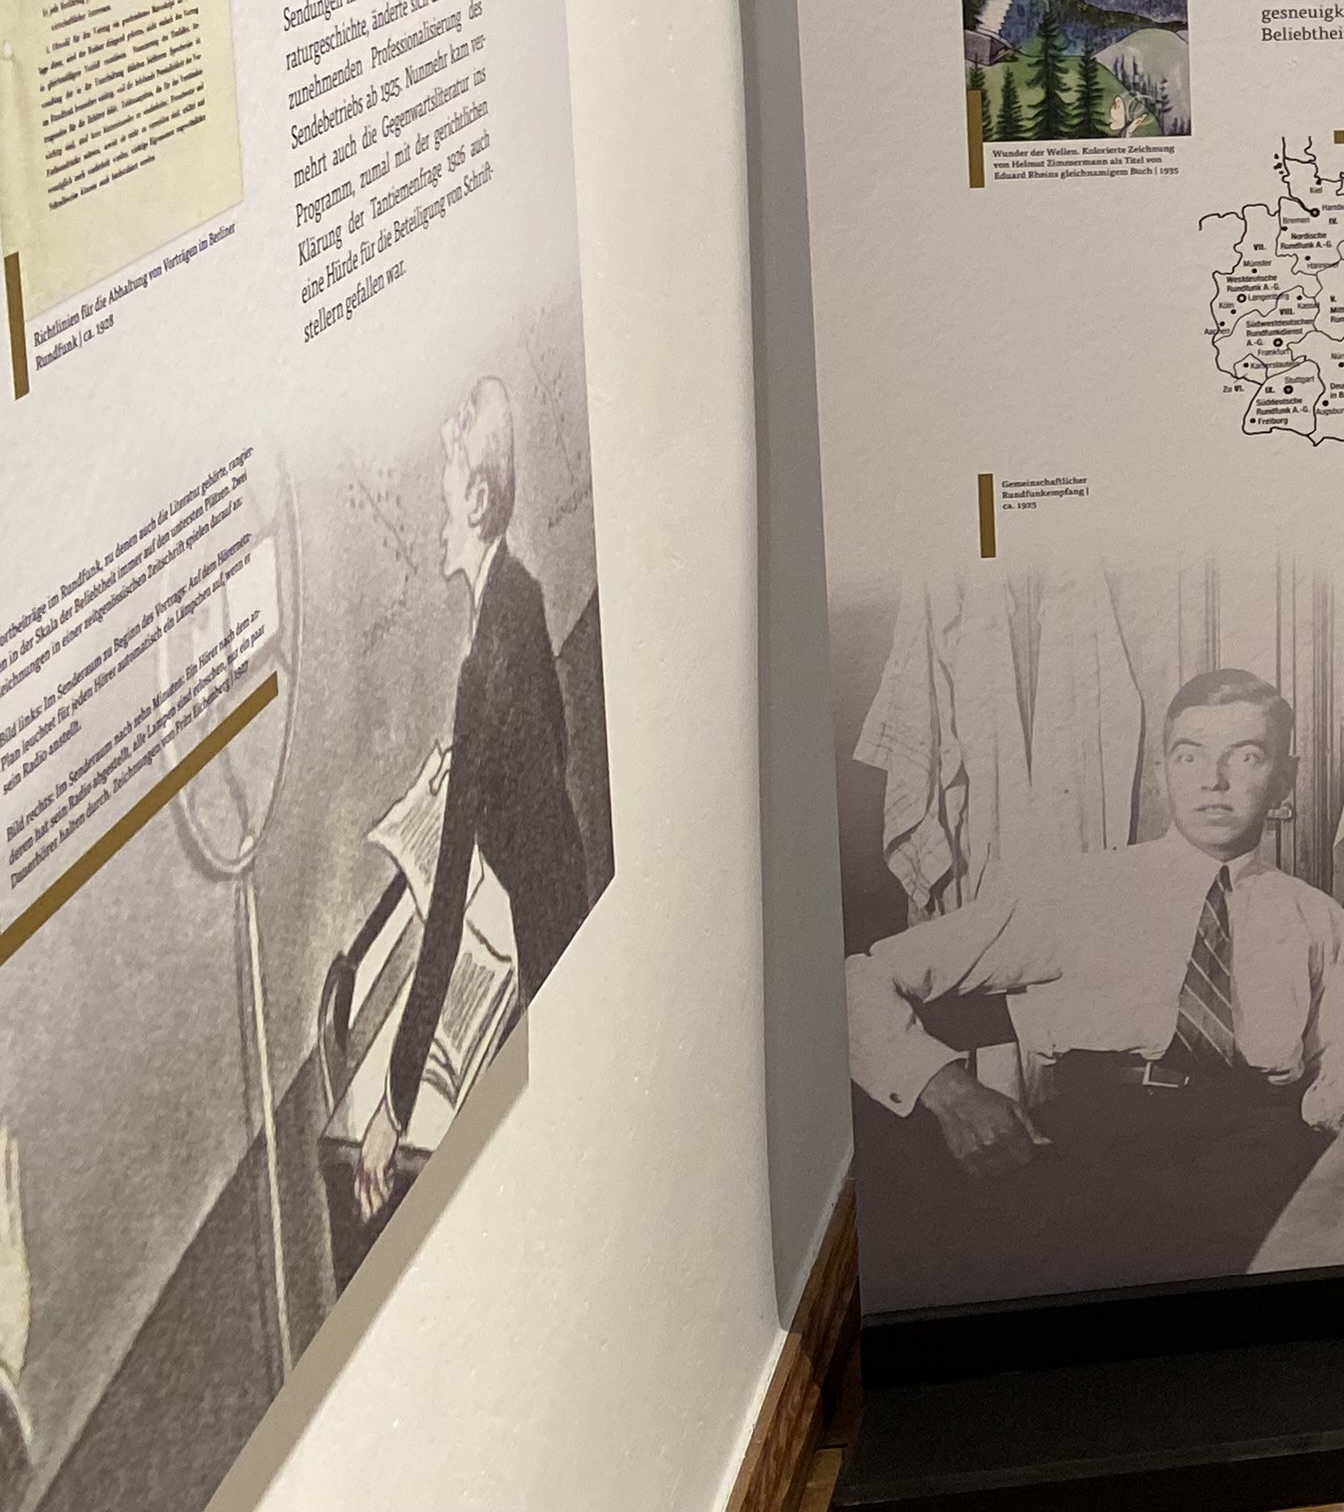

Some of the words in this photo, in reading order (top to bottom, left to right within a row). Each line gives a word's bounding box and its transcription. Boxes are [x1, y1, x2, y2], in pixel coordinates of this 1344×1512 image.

[1001, 476, 1088, 489] Gemeinschaftlicher
[1001, 487, 1085, 499] Rundfunkempfang
[1017, 501, 1037, 510] 1925
